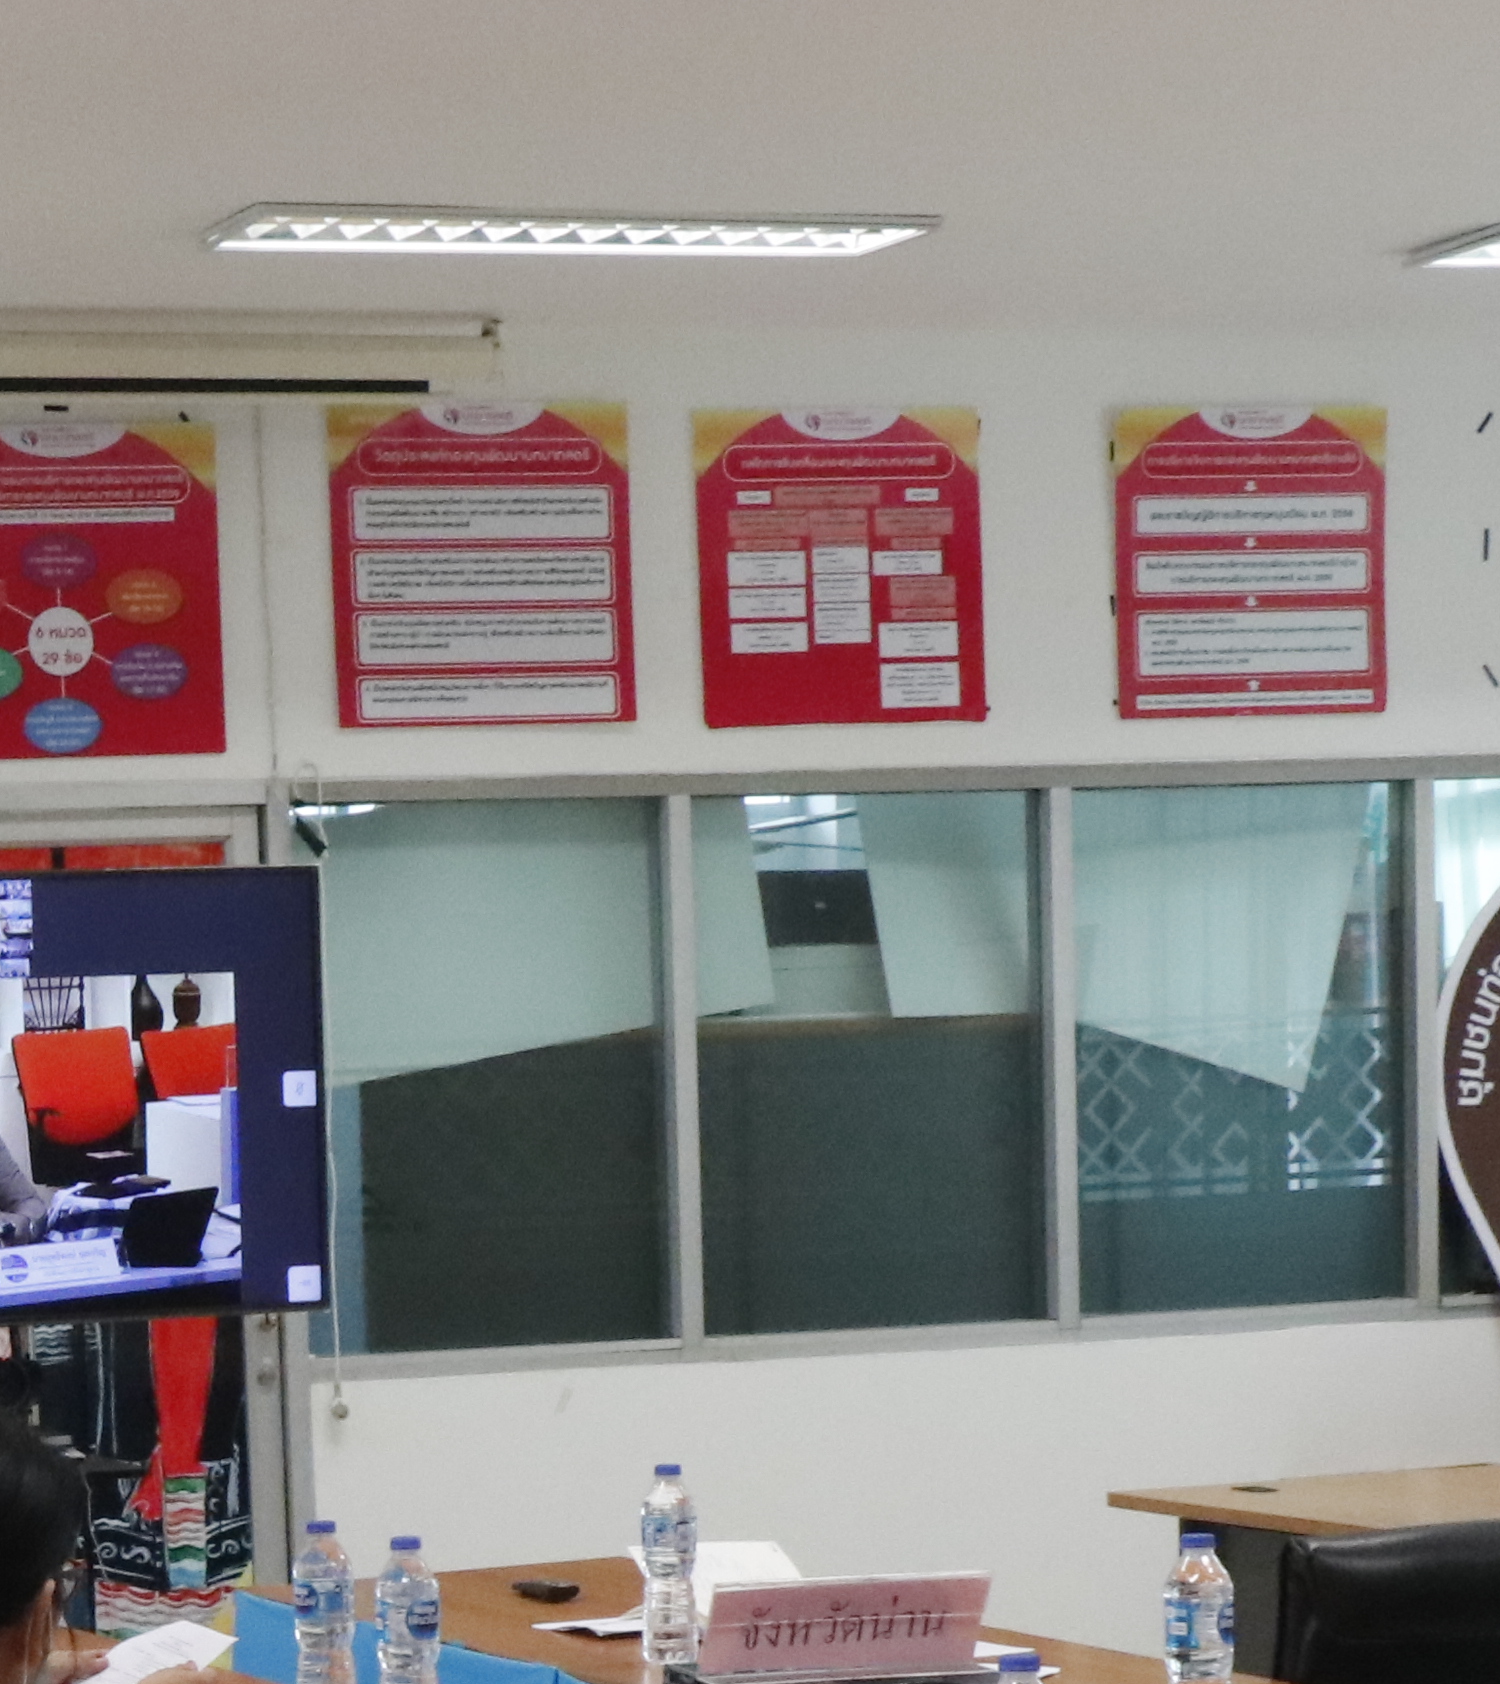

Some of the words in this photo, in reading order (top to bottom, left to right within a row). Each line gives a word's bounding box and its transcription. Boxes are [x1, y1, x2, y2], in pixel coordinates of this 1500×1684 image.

[743, 1595, 951, 1650] จังหวัดน่าน
